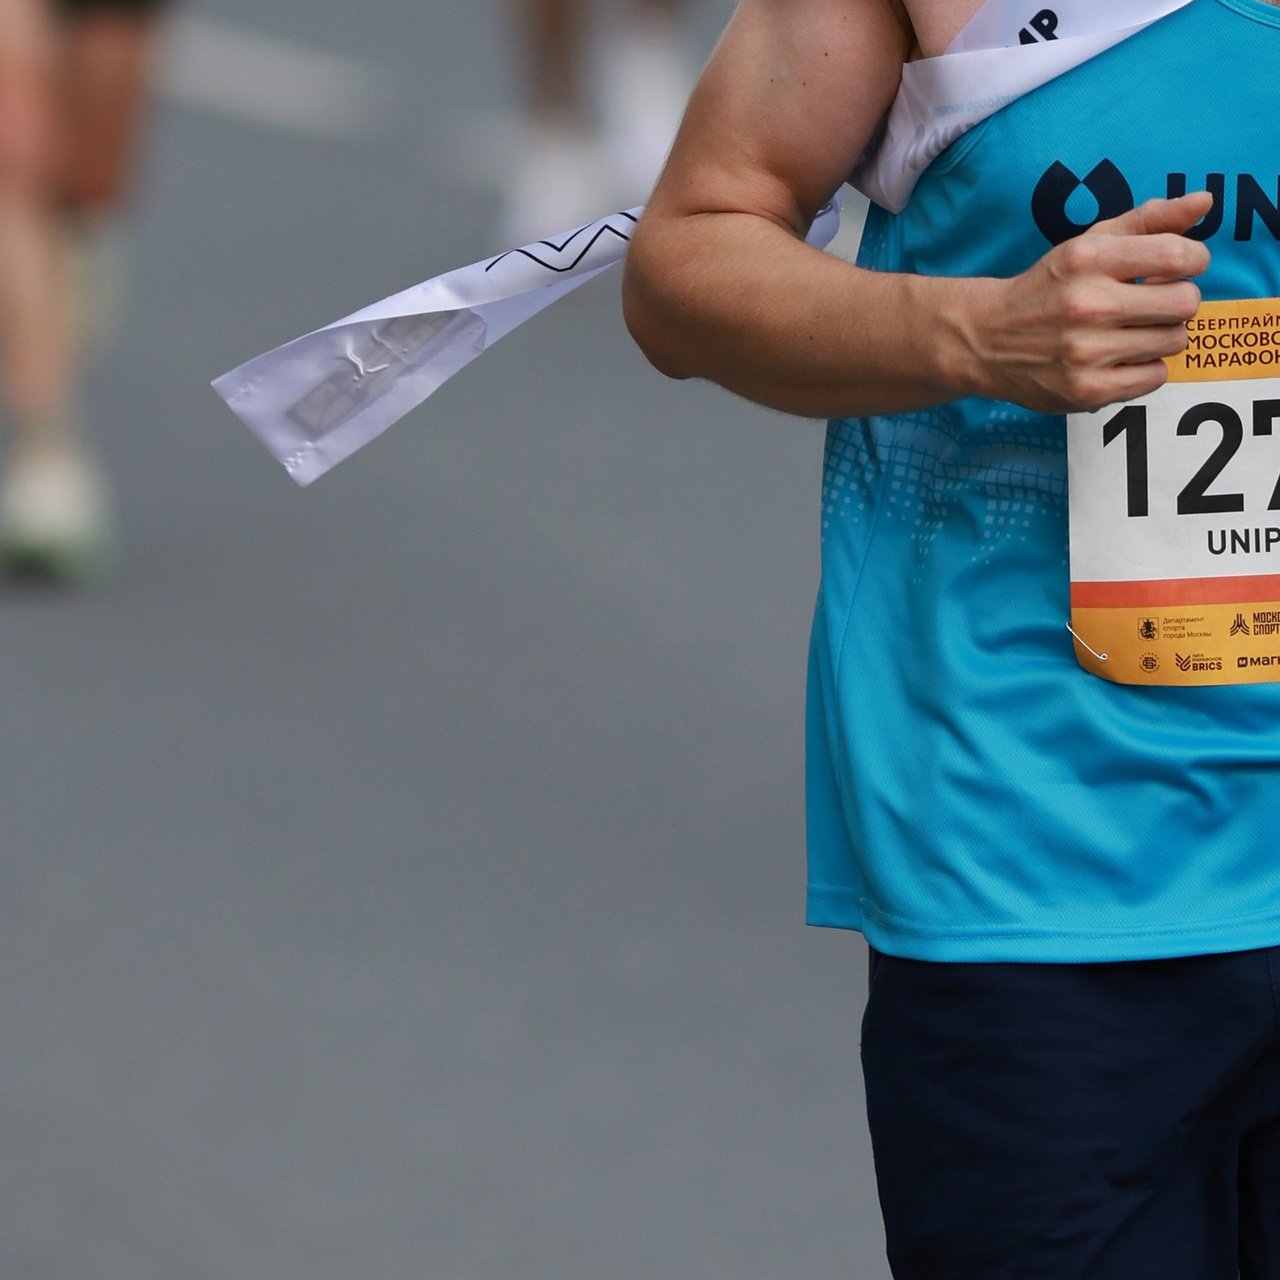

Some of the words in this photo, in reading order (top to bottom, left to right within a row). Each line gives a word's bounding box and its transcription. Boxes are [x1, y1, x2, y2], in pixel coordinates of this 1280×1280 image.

[1162, 616, 1205, 625] Департамент
[1162, 625, 1186, 633] спорта
[1252, 623, 1280, 636] СПОРТ
[1162, 632, 1186, 640] города
[1192, 661, 1223, 671] BRICS
